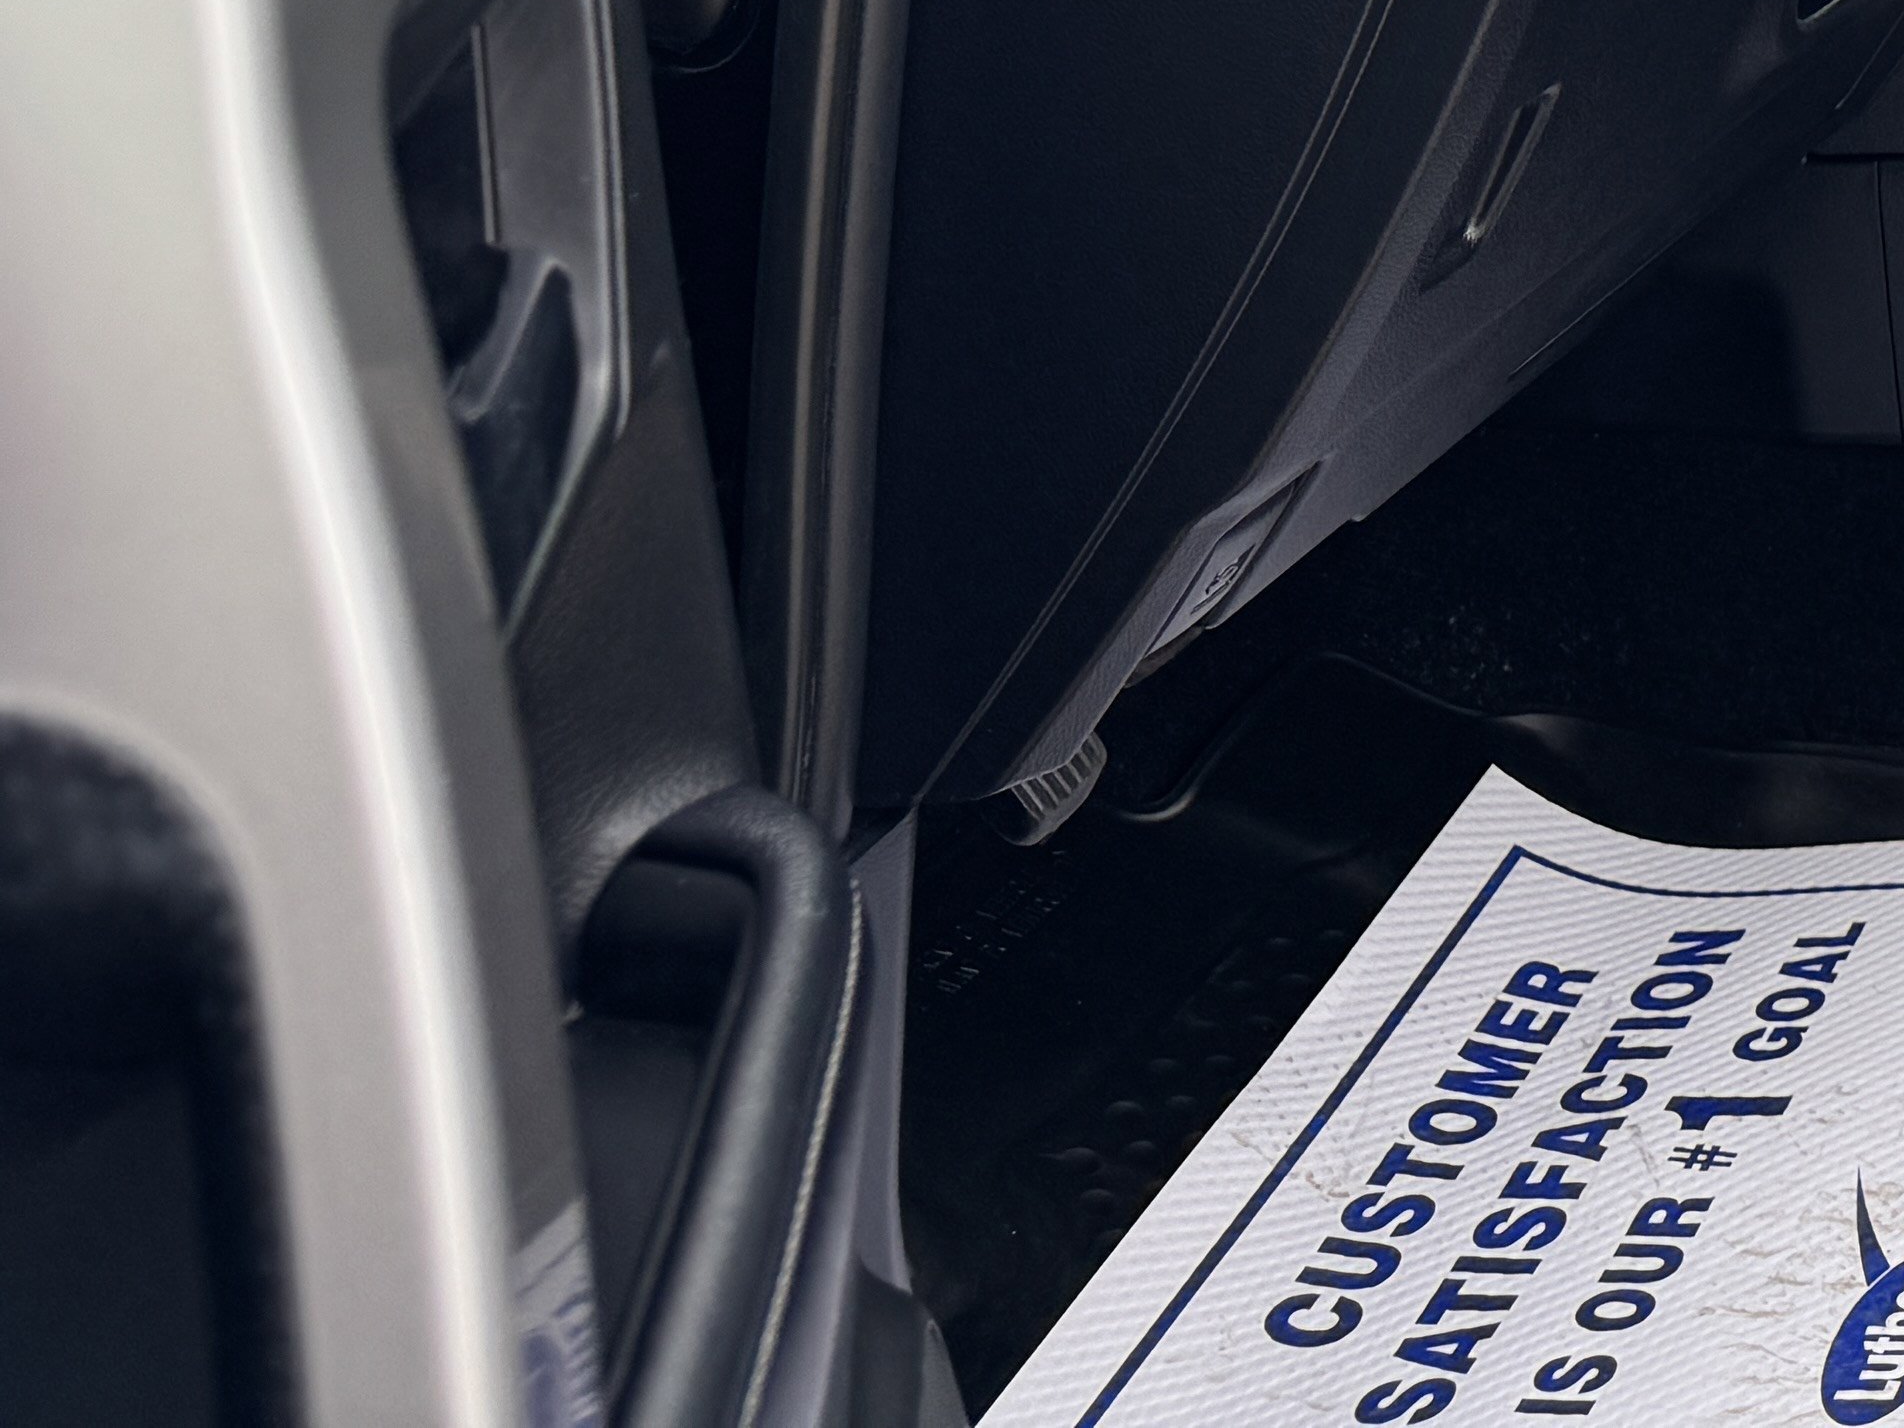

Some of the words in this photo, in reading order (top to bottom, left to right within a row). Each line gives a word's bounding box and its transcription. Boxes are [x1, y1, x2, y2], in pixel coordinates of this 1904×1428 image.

[1263, 960, 1599, 1348] CUSTOMER
[1354, 928, 1746, 1426] SATISFACTION
[1514, 1353, 1618, 1416] IS
[1574, 1196, 1716, 1332] OUR
[1663, 1094, 1794, 1172] #1
[1732, 921, 1867, 1062] GOAL
